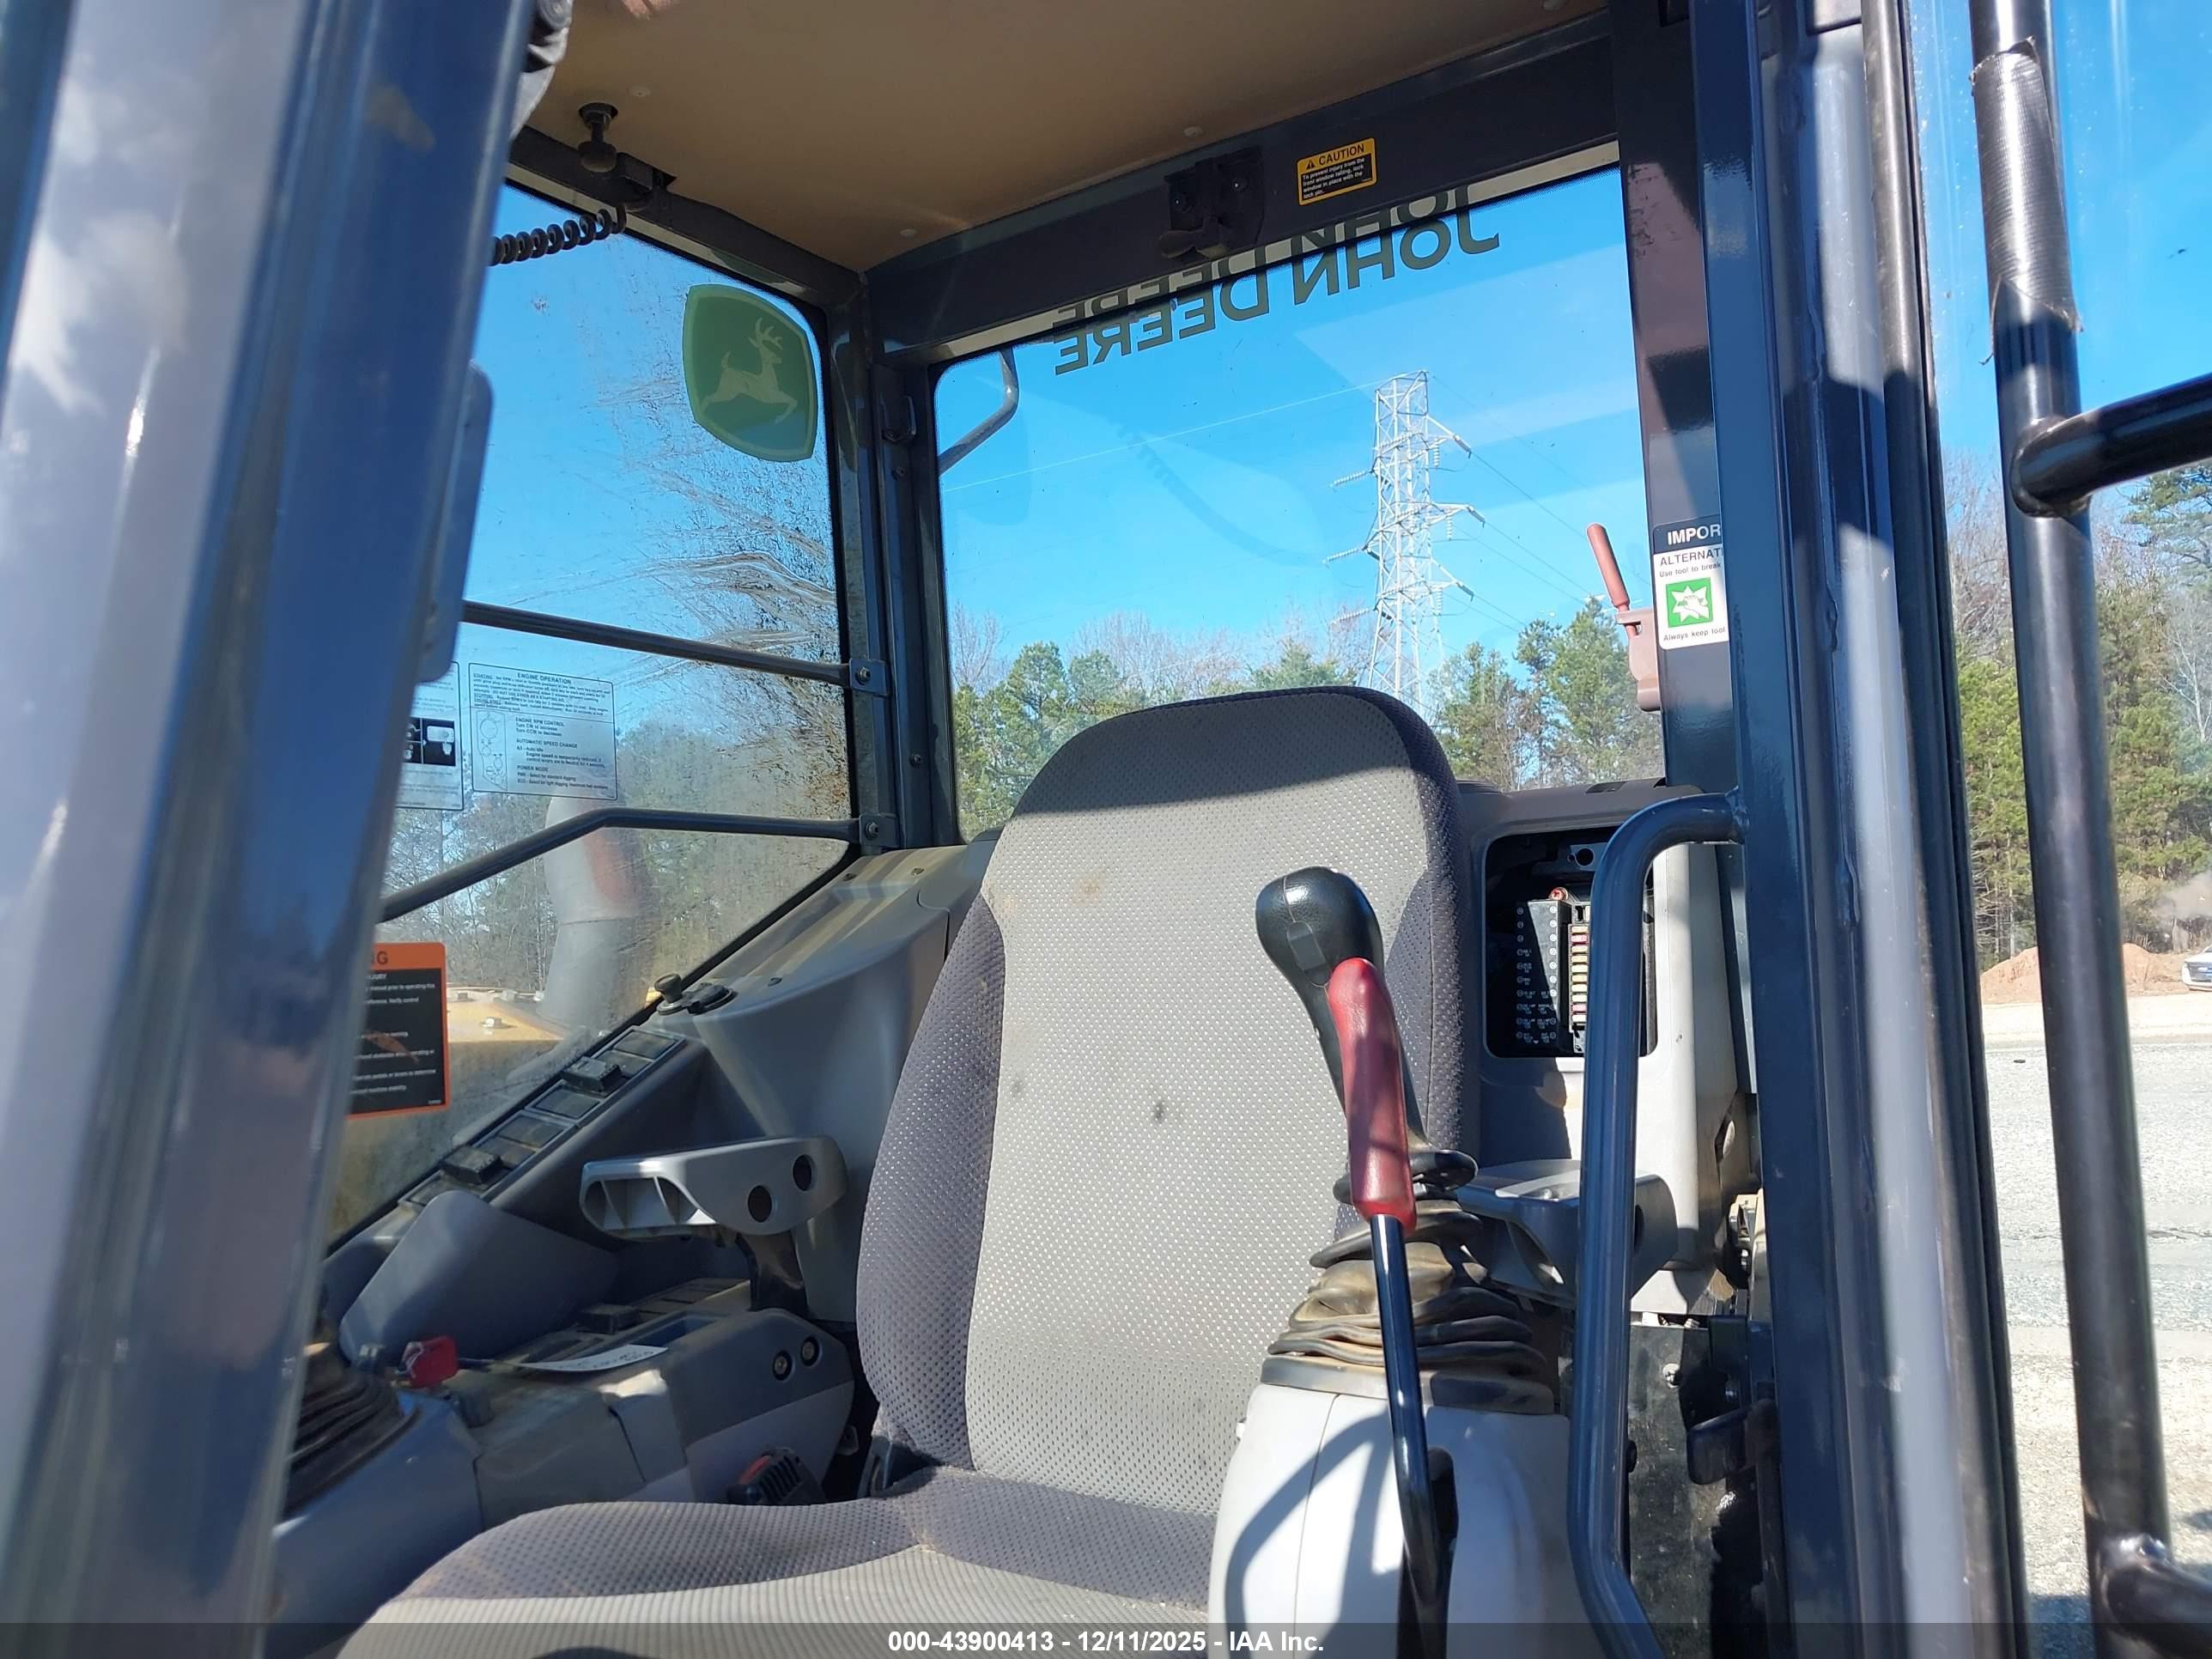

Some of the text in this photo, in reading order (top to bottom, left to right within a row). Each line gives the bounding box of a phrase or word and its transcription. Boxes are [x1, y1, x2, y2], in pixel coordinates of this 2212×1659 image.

[1319, 144, 1364, 165] CAUTION
[1310, 169, 1328, 179] prevent
[1316, 174, 1335, 182] window
[1335, 169, 1352, 178] falling,
[1304, 184, 1322, 192] window
[1329, 178, 1341, 186] place
[1667, 524, 1721, 545] IMPOR
[1660, 548, 1723, 567] ALTERNAT
[1664, 626, 1725, 641] Always keep tool
[540, 676, 571, 684] OPERATION
